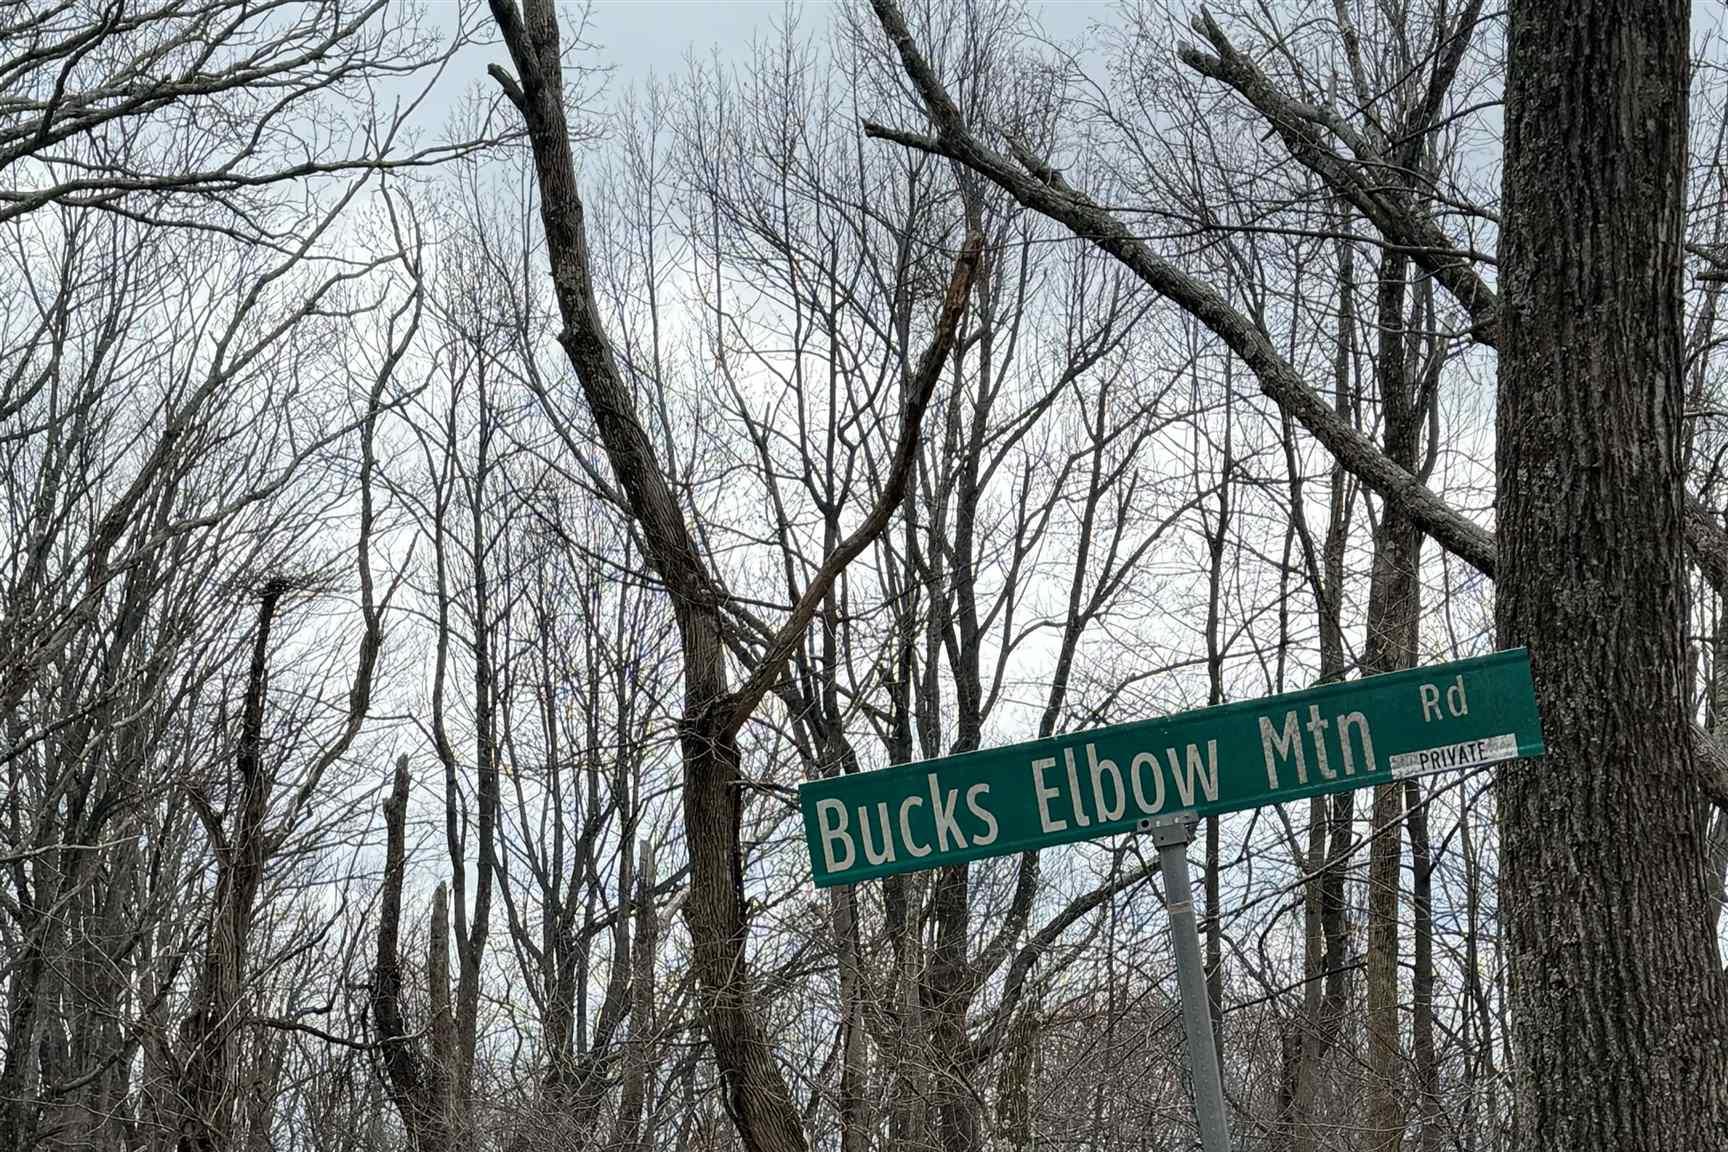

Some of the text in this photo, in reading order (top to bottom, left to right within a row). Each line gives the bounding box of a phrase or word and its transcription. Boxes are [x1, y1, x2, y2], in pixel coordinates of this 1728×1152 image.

[816, 674, 1469, 873] Bucks Elbow Mtn Rd
[1419, 741, 1489, 771] PRIVATE
